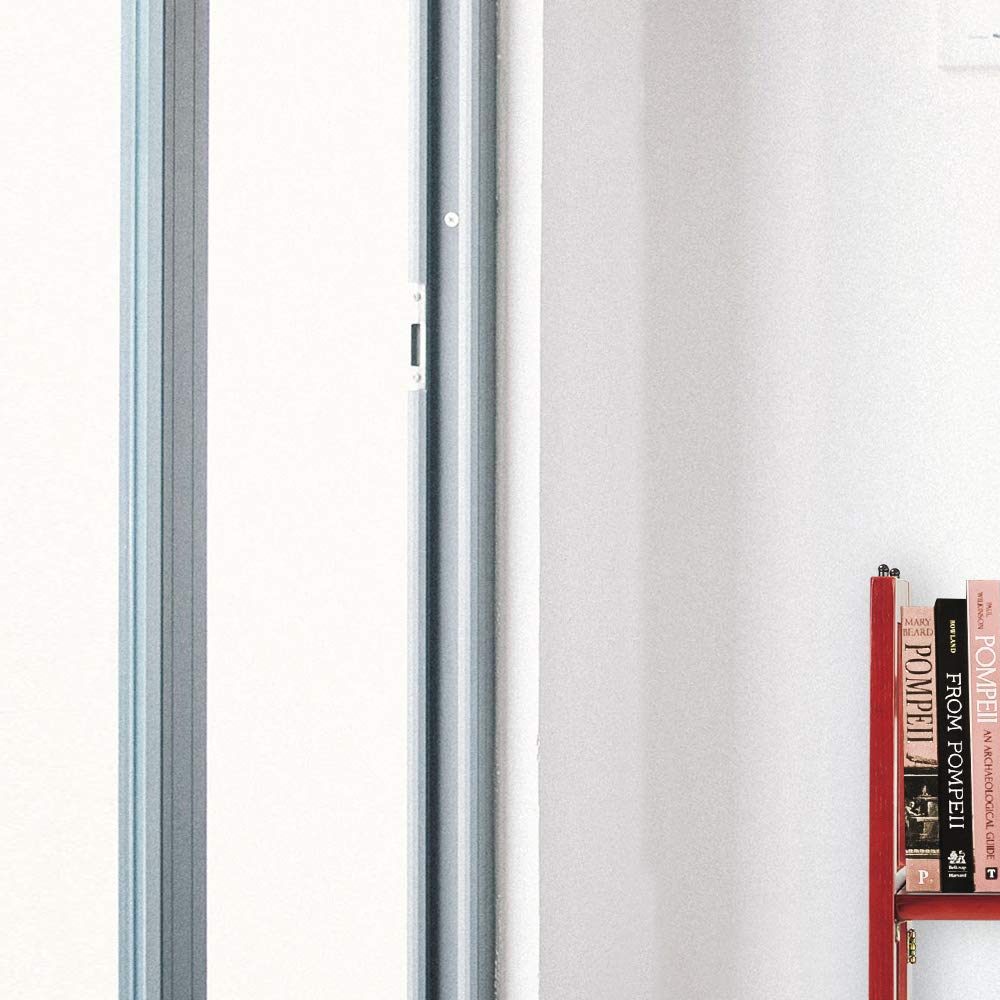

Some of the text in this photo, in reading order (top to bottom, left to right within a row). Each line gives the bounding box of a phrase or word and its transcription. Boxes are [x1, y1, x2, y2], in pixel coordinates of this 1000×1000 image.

[902, 628, 934, 637] BEARD
[904, 618, 932, 626] MARY
[976, 592, 984, 630] WILKINSON
[904, 643, 934, 743] POMPEII
[975, 635, 998, 723] POMPEII
[945, 672, 965, 829] FROM POMPEII
[983, 729, 995, 860] AN ARCHAEOLOGICAL GUIDE
